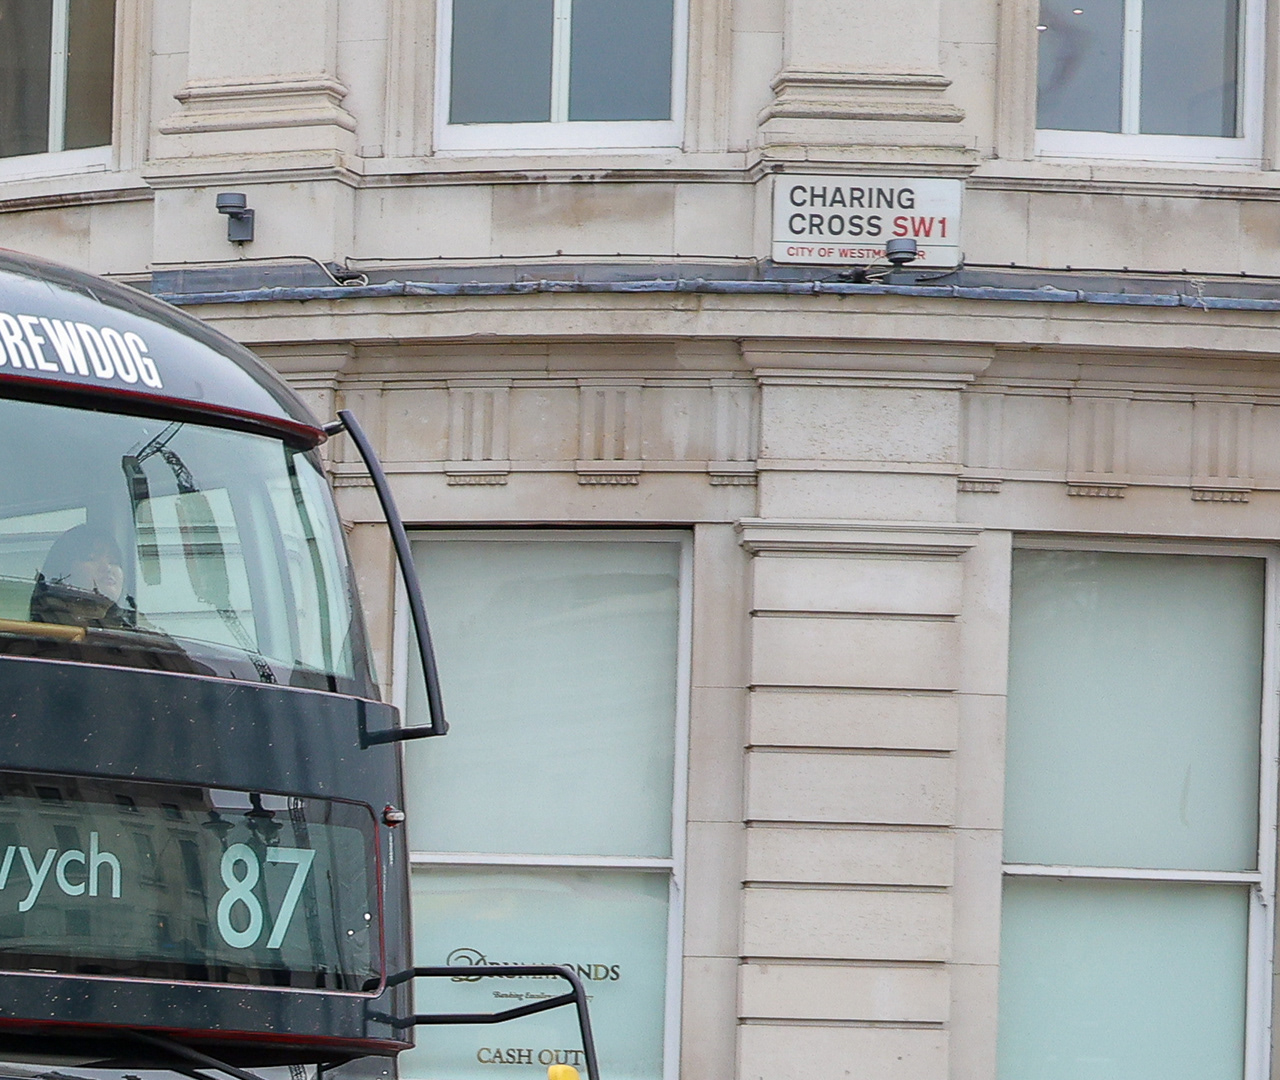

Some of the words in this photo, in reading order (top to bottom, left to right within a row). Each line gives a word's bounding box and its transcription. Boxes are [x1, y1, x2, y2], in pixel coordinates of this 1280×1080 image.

[790, 185, 915, 210] CHARING
[788, 213, 882, 237] CROSS
[892, 215, 947, 238] SW1
[786, 246, 814, 258] CITY
[817, 247, 834, 258] OF
[216, 843, 317, 950] 87
[476, 1048, 533, 1065] CASH
[538, 1049, 585, 1066] OUT
